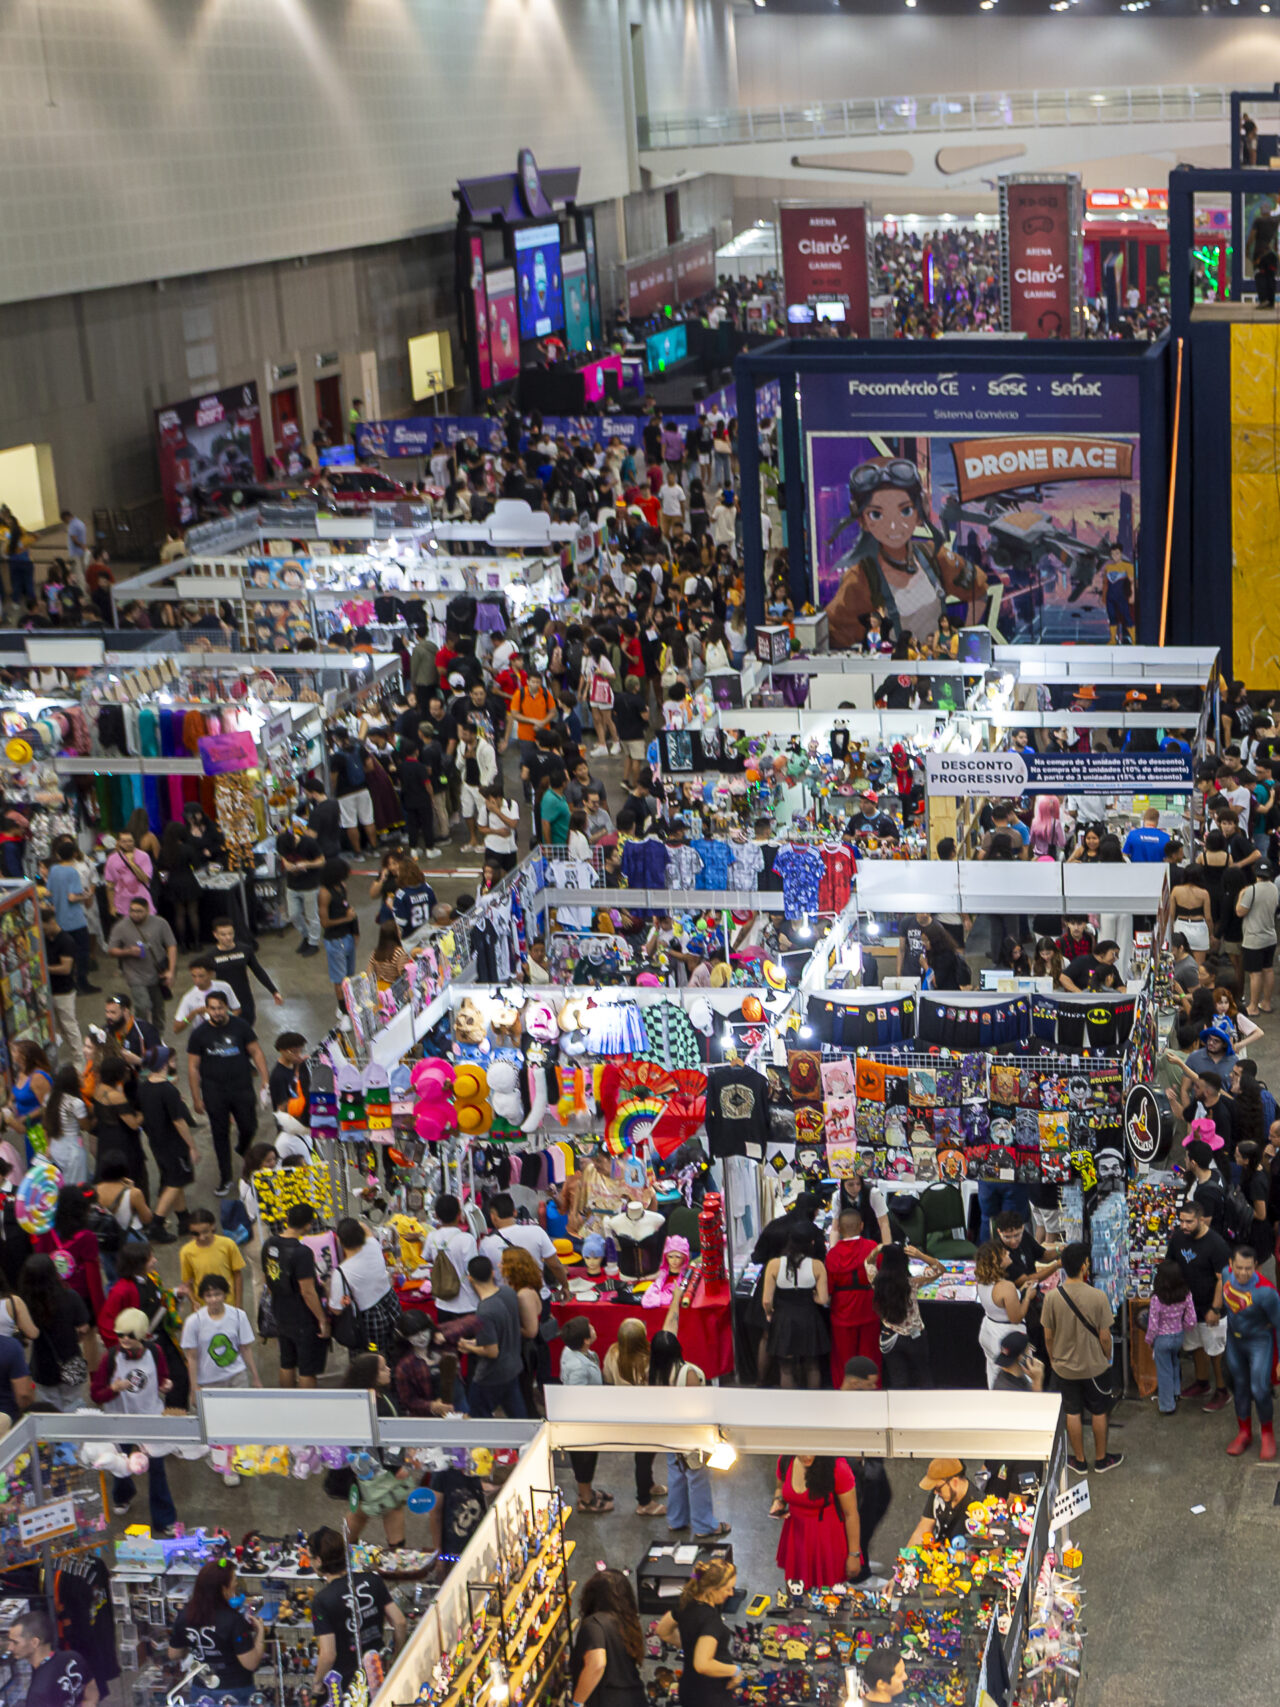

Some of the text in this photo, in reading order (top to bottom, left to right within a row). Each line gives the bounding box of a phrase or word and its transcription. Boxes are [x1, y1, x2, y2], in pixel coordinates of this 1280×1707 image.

[809, 218, 837, 227] ARENA
[798, 234, 849, 255] Claro
[1026, 248, 1052, 256] ARENA
[1014, 264, 1064, 284] Claro
[1024, 289, 1057, 298] GAMING
[848, 380, 959, 397] Fecomércio CE
[987, 380, 1028, 397] Sesc
[1050, 380, 1102, 397] Senac
[933, 409, 1020, 420] Sistema Comércio
[964, 447, 1117, 479] DRONE RACE
[941, 761, 1013, 770] DESCONTO
[1034, 758, 1045, 766] Na
[1046, 759, 1074, 767] compra
[1092, 758, 1121, 766] unidade
[1148, 758, 1185, 767] desconto)
[1030, 766, 1041, 774] Na
[1042, 767, 1070, 775] compra
[1088, 766, 1121, 774] unidades
[1152, 766, 1189, 775] desconto)
[930, 774, 1024, 783] PROGRESSIVO
[411, 903, 430, 929] 21
